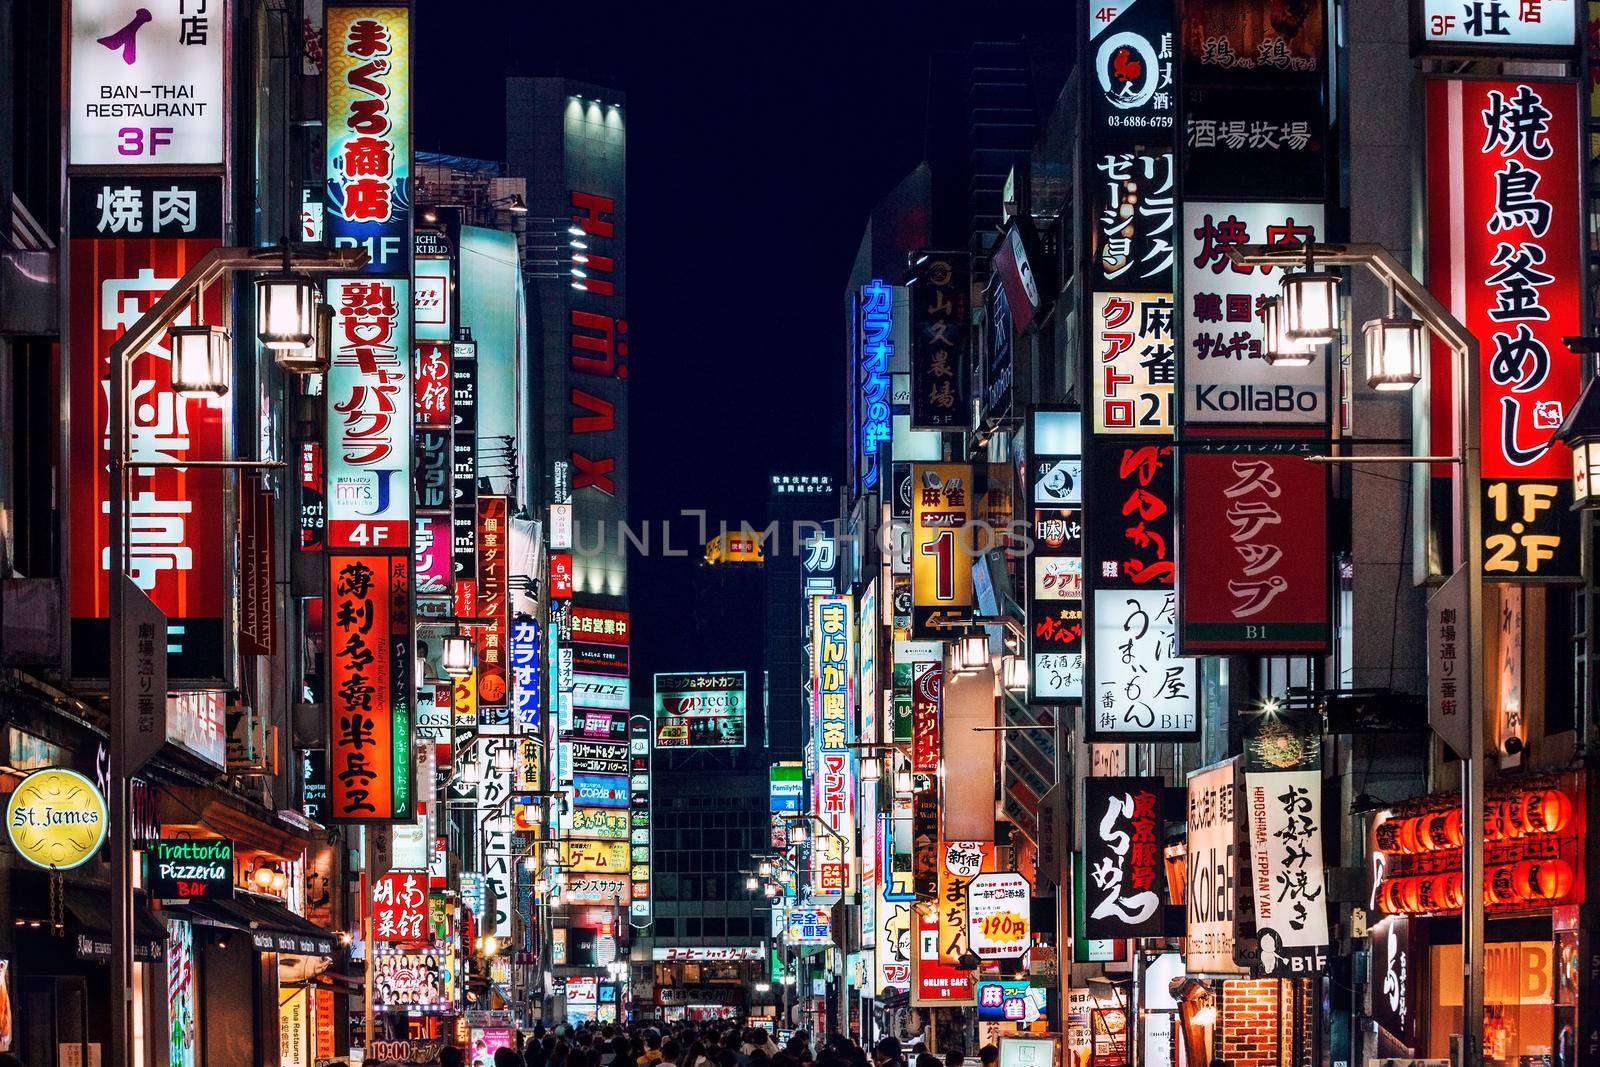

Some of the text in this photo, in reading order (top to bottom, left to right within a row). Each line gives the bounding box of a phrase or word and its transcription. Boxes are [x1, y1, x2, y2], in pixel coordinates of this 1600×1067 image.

[1095, 7, 1117, 22] 4F
[1431, 15, 1456, 35] 3F
[100, 86, 194, 99] BAN-THAI
[86, 103, 207, 117] RESTAURANT
[346, 19, 391, 222] まぐろ商店
[1108, 115, 1173, 128] 03-6886-6759
[117, 128, 173, 155] 3F
[1187, 119, 1312, 150] 酒場牧場
[97, 186, 198, 233] 焼肉
[1097, 153, 1134, 281] ゼーション
[1481, 85, 1556, 467] 焼鳥釜めし
[334, 282, 405, 466] 熟女キャバクラ
[1101, 297, 1135, 427] クアトロ
[1195, 384, 1318, 412] KollaBo
[425, 433, 444, 506] レンタル
[921, 488, 965, 507] 麻雀
[1487, 483, 1559, 523] 1F
[923, 514, 964, 523] ナンバー
[349, 523, 388, 546] 4F
[1223, 459, 1288, 618] ステップ
[1484, 535, 1561, 573] 2F
[572, 616, 626, 635] 全店営業中
[1246, 626, 1267, 639] B1
[915, 665, 928, 673] 3F
[1118, 598, 1155, 729] うまいもん
[1439, 607, 1457, 717] 劇場通り一番街
[138, 622, 155, 734] 劇場通り一番街
[822, 605, 845, 750] まんが喫茶
[1100, 682, 1117, 730] 一番街
[1160, 713, 1194, 729] B1F
[524, 742, 537, 783] 麻雀
[826, 755, 846, 830] マンボー
[45, 807, 98, 826] James
[1254, 786, 1268, 844] HIROSHIMA
[572, 850, 607, 866] ゲーム
[948, 850, 981, 867] 新宿
[1273, 784, 1322, 931] お好み焼き
[176, 881, 208, 897] Bar
[1290, 955, 1327, 971] B1F
[923, 979, 968, 987] ONLINE CAFE
[941, 989, 951, 997] B1
[372, 1041, 411, 1061] 19:00
